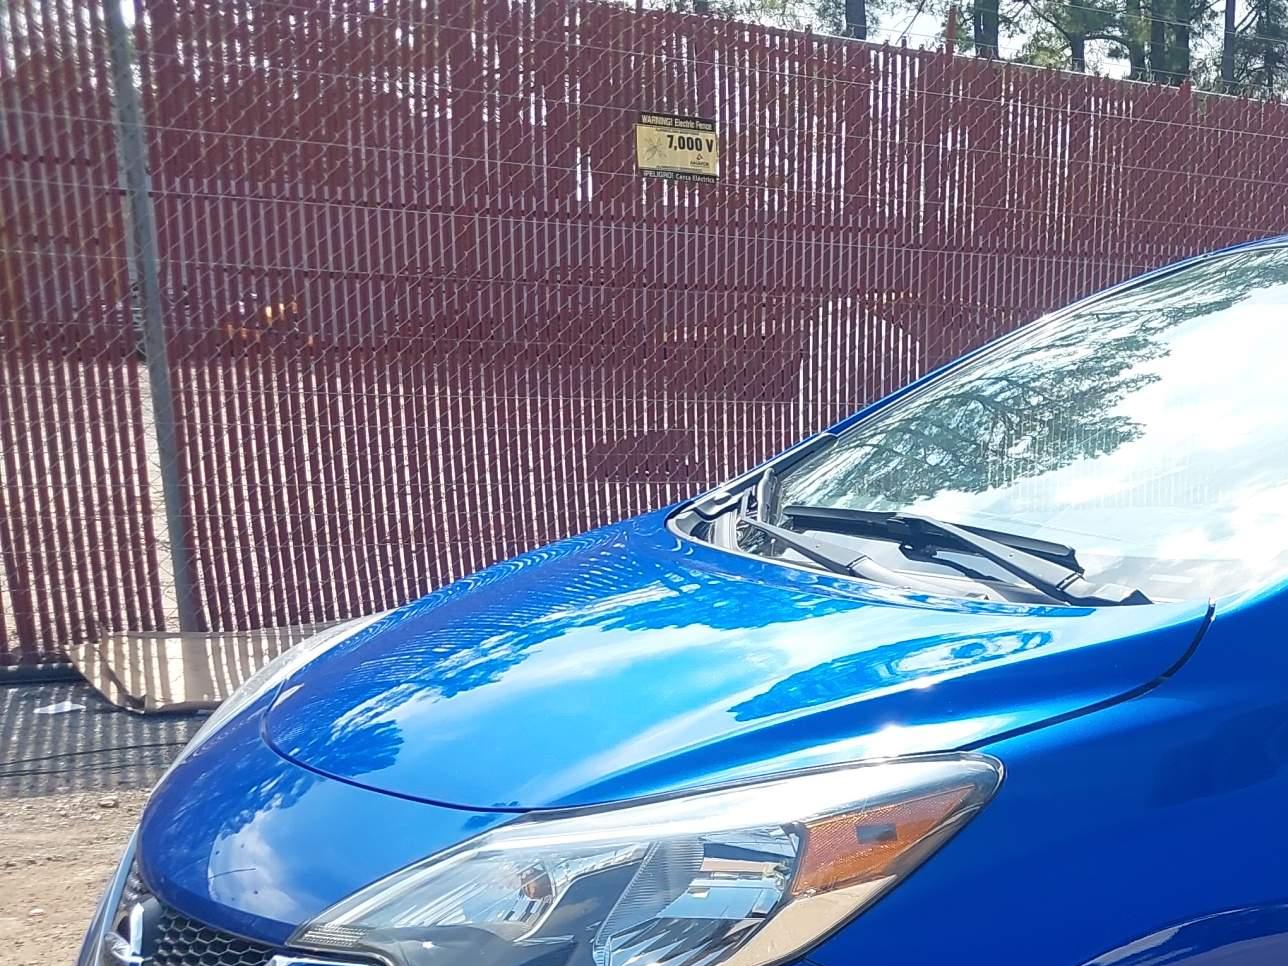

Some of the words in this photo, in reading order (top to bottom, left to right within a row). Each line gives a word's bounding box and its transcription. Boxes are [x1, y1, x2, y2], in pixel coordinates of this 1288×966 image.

[641, 115, 673, 126] WARNING!
[675, 118, 695, 128] Electric
[696, 121, 712, 131] Fence
[667, 135, 702, 151] 7,000
[705, 139, 714, 153] V
